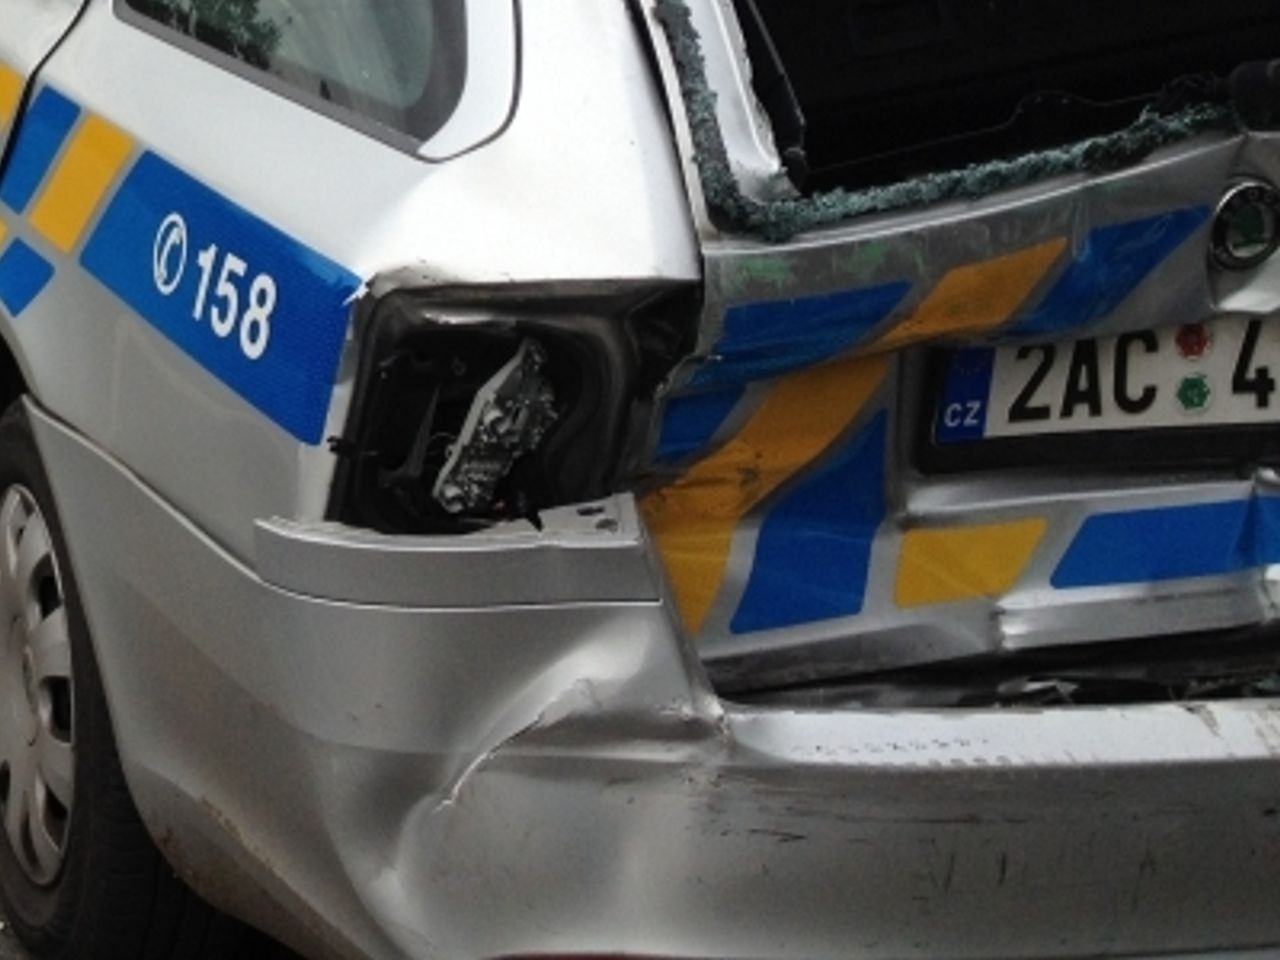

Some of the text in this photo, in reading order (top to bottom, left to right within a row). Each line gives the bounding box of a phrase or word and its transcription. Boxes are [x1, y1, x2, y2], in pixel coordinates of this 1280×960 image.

[192, 243, 277, 360] 158
[943, 401, 981, 428] CZ
[1008, 329, 1159, 424] 2AC
